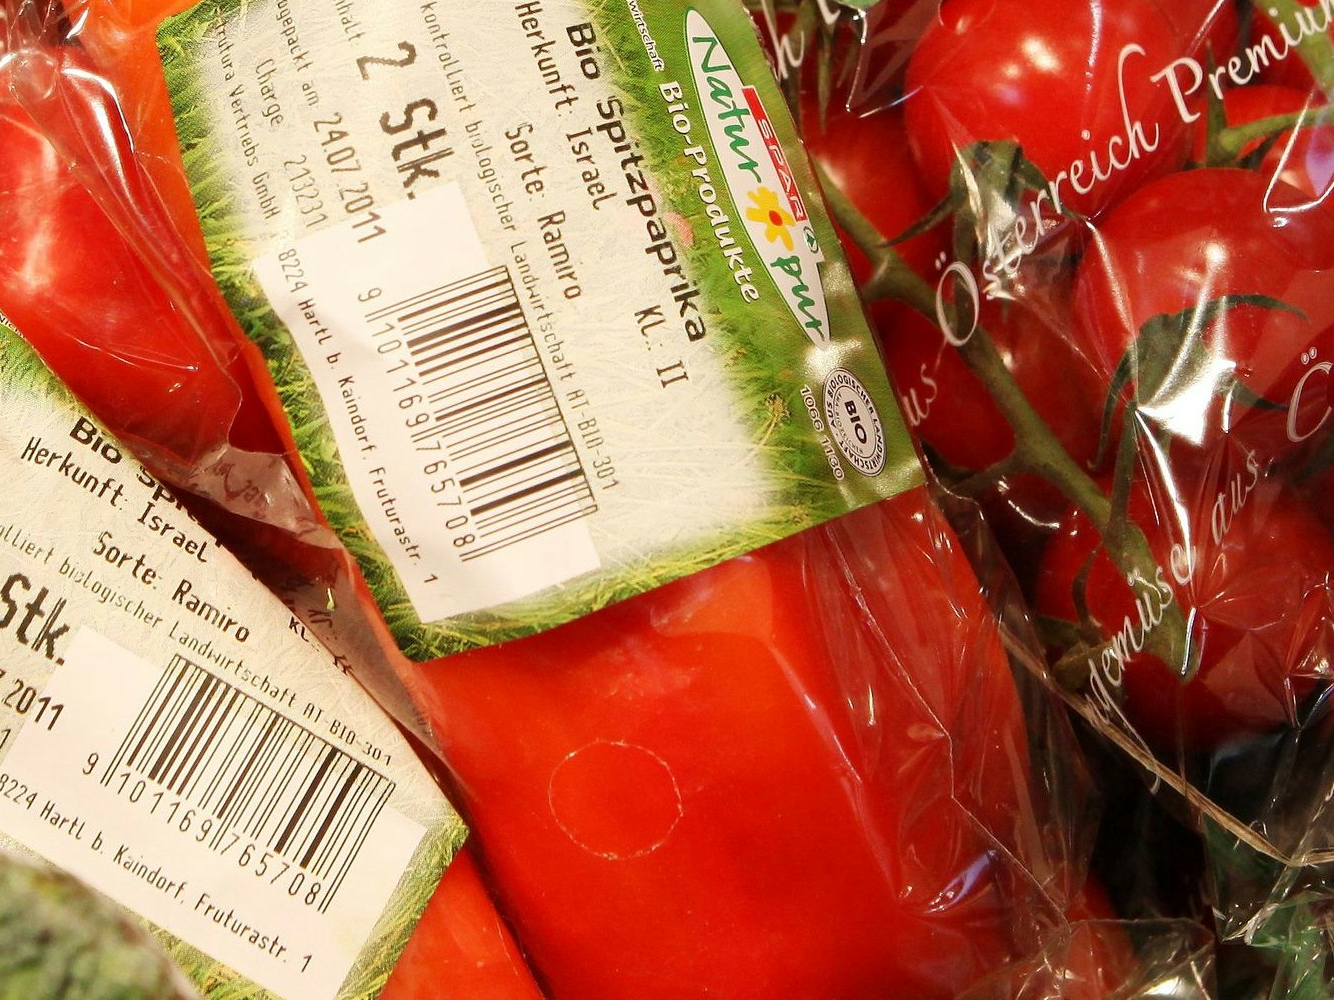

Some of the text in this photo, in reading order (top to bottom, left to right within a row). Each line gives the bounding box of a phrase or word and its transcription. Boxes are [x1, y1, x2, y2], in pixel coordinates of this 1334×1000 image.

[356, 40, 417, 81] 2
[515, 0, 619, 211] Herkunft: Israel
[283, 154, 330, 229] 213231
[313, 110, 387, 244] 24.07.2011
[379, 98, 455, 200] Stk.
[420, 0, 477, 113] kontrolliert
[465, 119, 518, 233] biologischer
[509, 239, 577, 383] Landwirtschaft
[505, 120, 582, 301] Sorte: Ramiro
[566, 21, 708, 343] Bio Spitzpaprika
[658, 81, 760, 304] Bio-Produkte
[692, 36, 825, 342] Natur pur
[755, 116, 808, 222] SPAR
[932, 41, 1161, 348] Österreich
[228, 83, 260, 168] Vertriebs
[251, 171, 282, 220] GmbH
[297, 297, 333, 346] Hartl
[369, 466, 422, 567] Fruturastr.
[423, 572, 439, 585] 1
[357, 287, 476, 548] 9 101169 765708
[800, 384, 845, 481] 1066 1130
[844, 400, 868, 445] BIO
[20, 435, 130, 512] Herkunft:
[136, 501, 210, 564] Israel
[1210, 449, 1261, 546] aus
[59, 556, 164, 630] biologischer
[168, 621, 298, 707] Landwirtschaft
[90, 530, 164, 591] Sorte:
[171, 578, 251, 644] Ramiro
[38, 800, 84, 841] Hartl
[90, 831, 105, 856] b.
[193, 892, 289, 964] Fruturastr.
[301, 953, 314, 974] 1
[81, 752, 323, 907] 9 101169 765708
